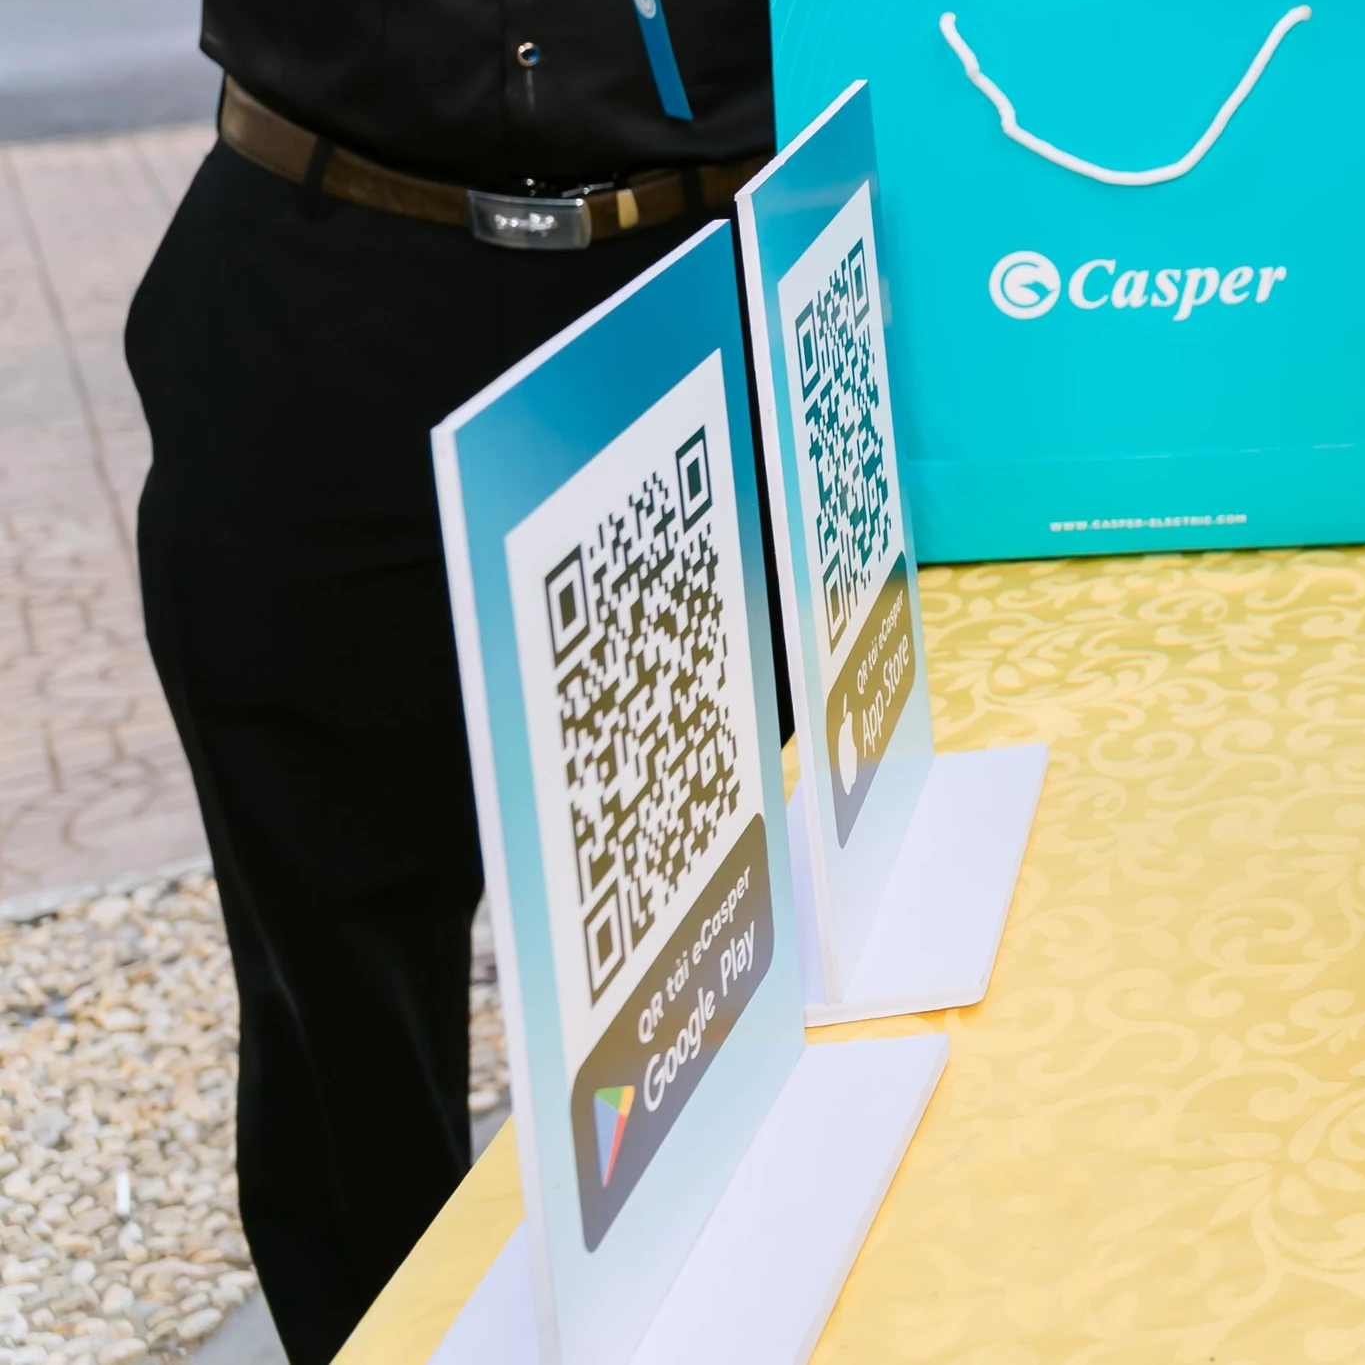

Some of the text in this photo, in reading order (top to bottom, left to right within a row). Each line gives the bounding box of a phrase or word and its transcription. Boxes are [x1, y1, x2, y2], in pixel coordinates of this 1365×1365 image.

[1067, 258, 1288, 322] Casper
[856, 659, 868, 695] QR
[878, 589, 904, 650] eCasper
[862, 633, 910, 759] App Store
[638, 865, 752, 1044] QR tải eCasper
[643, 921, 755, 1113] Google Play
